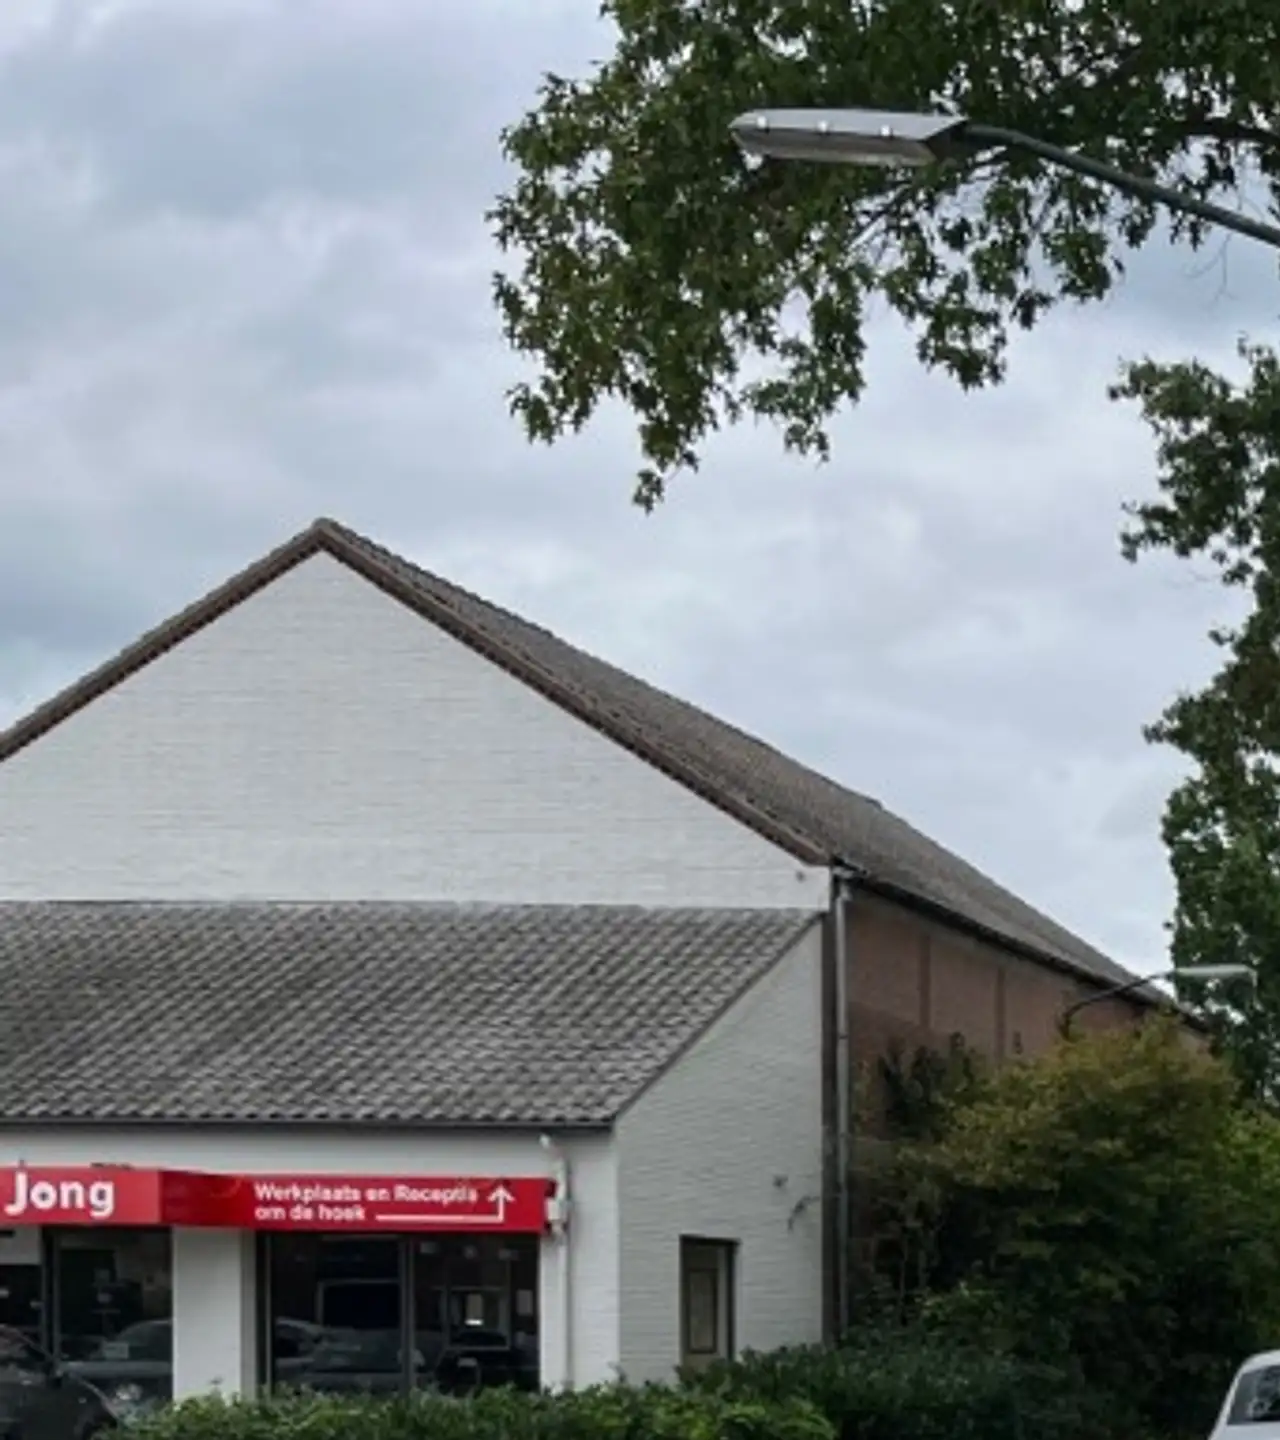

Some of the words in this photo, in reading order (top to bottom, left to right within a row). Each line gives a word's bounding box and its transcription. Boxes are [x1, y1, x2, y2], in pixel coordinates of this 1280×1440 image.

[4, 1171, 115, 1220] Jong
[254, 1183, 361, 1204] Werkplaats
[365, 1187, 390, 1201] en
[394, 1184, 477, 1206] Receptie
[254, 1207, 286, 1220] om
[290, 1204, 313, 1220] de
[318, 1204, 365, 1220] hoek
